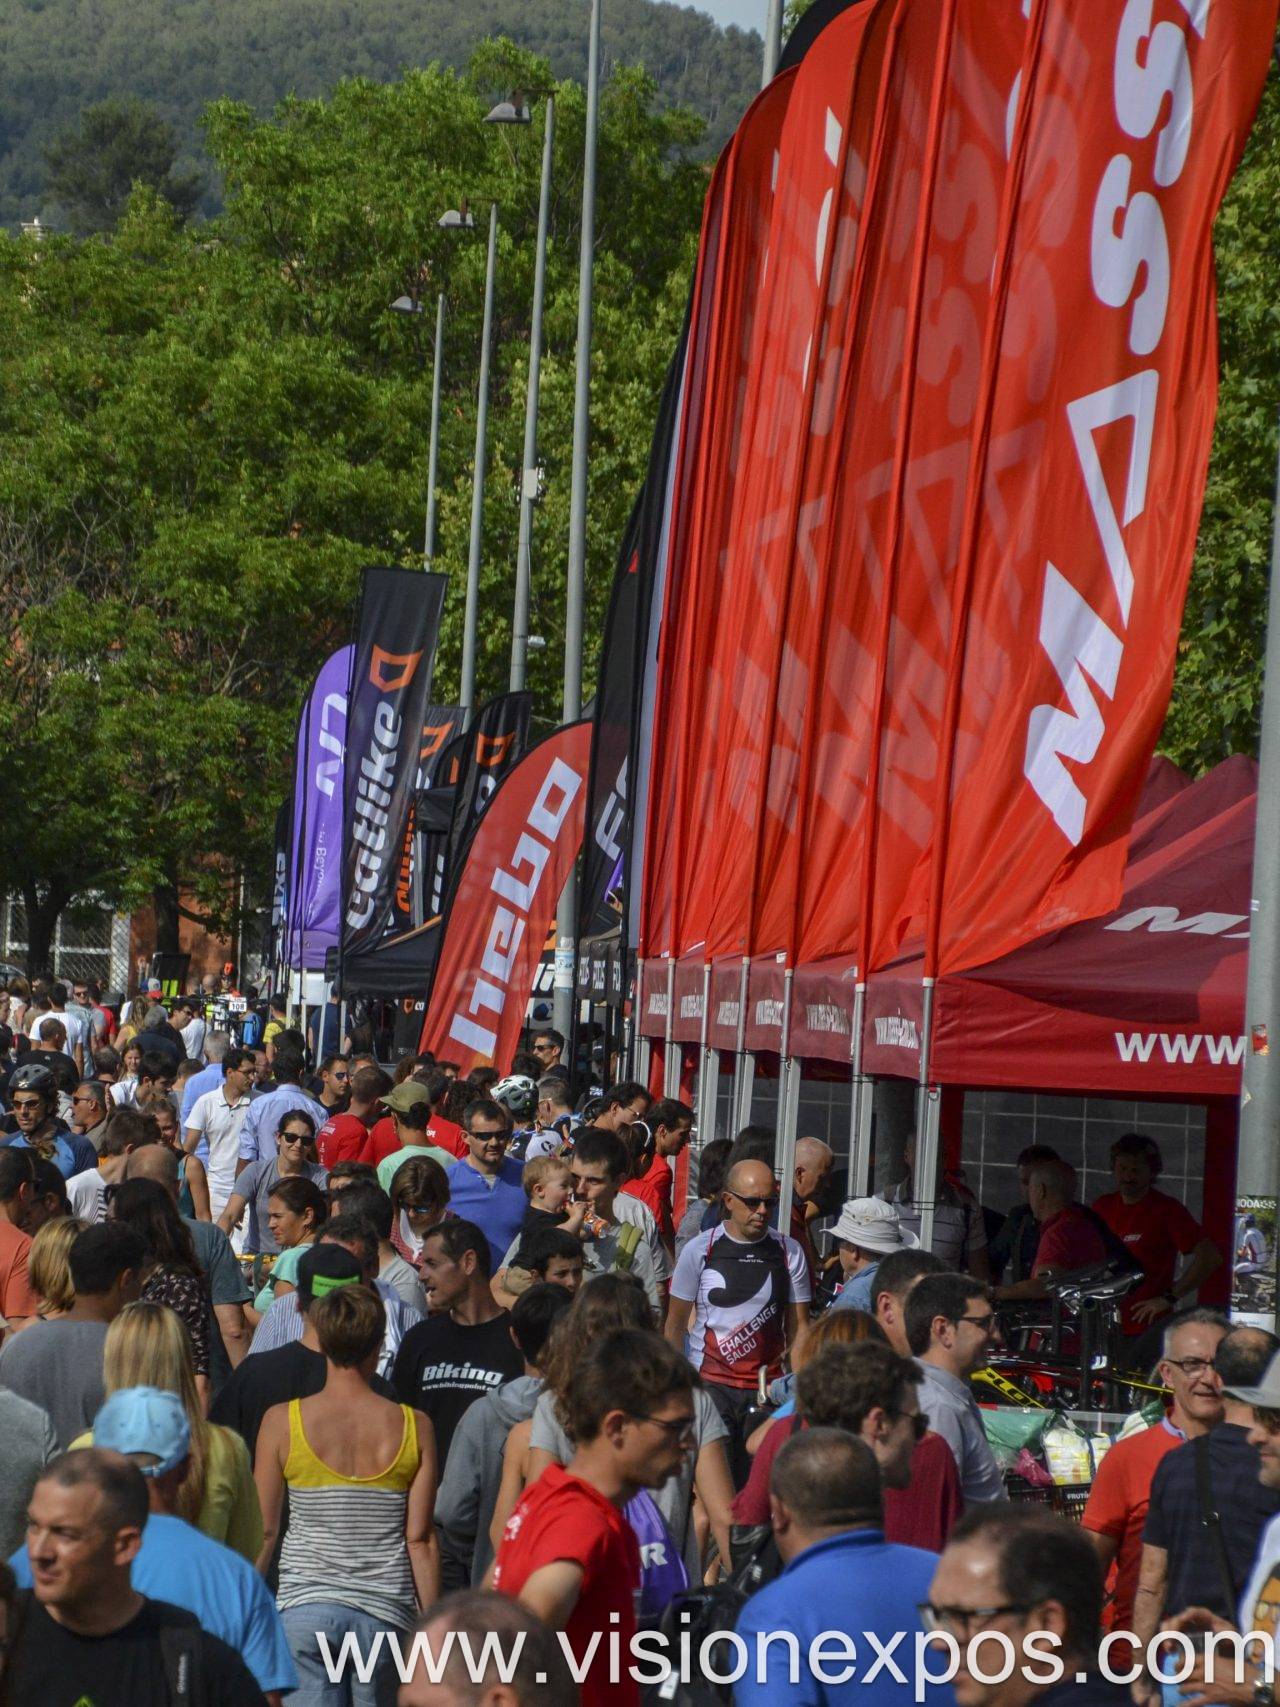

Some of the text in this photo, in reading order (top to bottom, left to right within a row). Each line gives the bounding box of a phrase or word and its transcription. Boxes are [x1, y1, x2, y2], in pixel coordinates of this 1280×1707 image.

[346, 701, 403, 931] catlike
[448, 756, 582, 1059] hebo
[720, 1302, 778, 1356] CHALLENGE
[726, 1337, 757, 1365] SALOU
[422, 1362, 504, 1386] Biking
